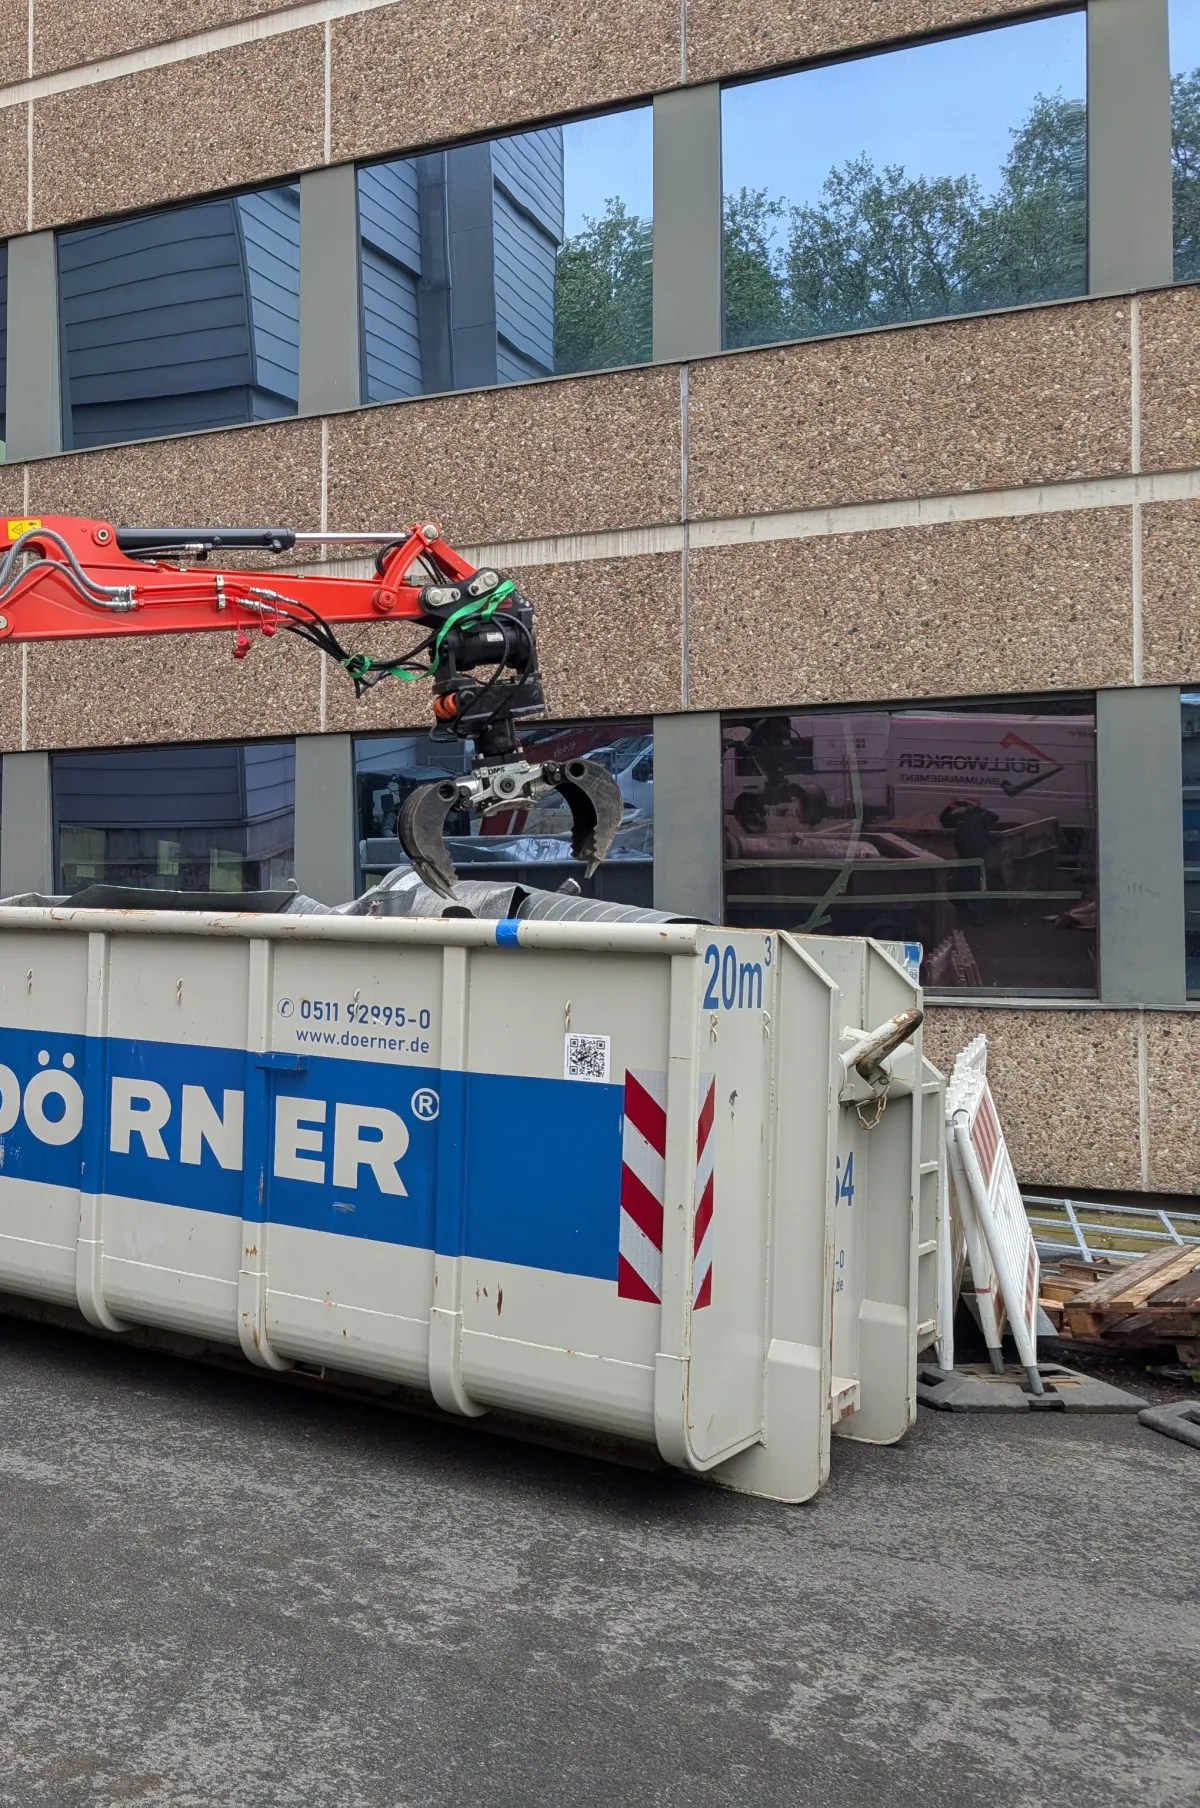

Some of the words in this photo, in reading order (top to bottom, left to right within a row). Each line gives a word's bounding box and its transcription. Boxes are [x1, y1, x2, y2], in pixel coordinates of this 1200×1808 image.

[300, 1000, 339, 1022] 0511
[346, 1003, 431, 1030] 92995-0
[296, 1029, 430, 1054] www.doerner.de
